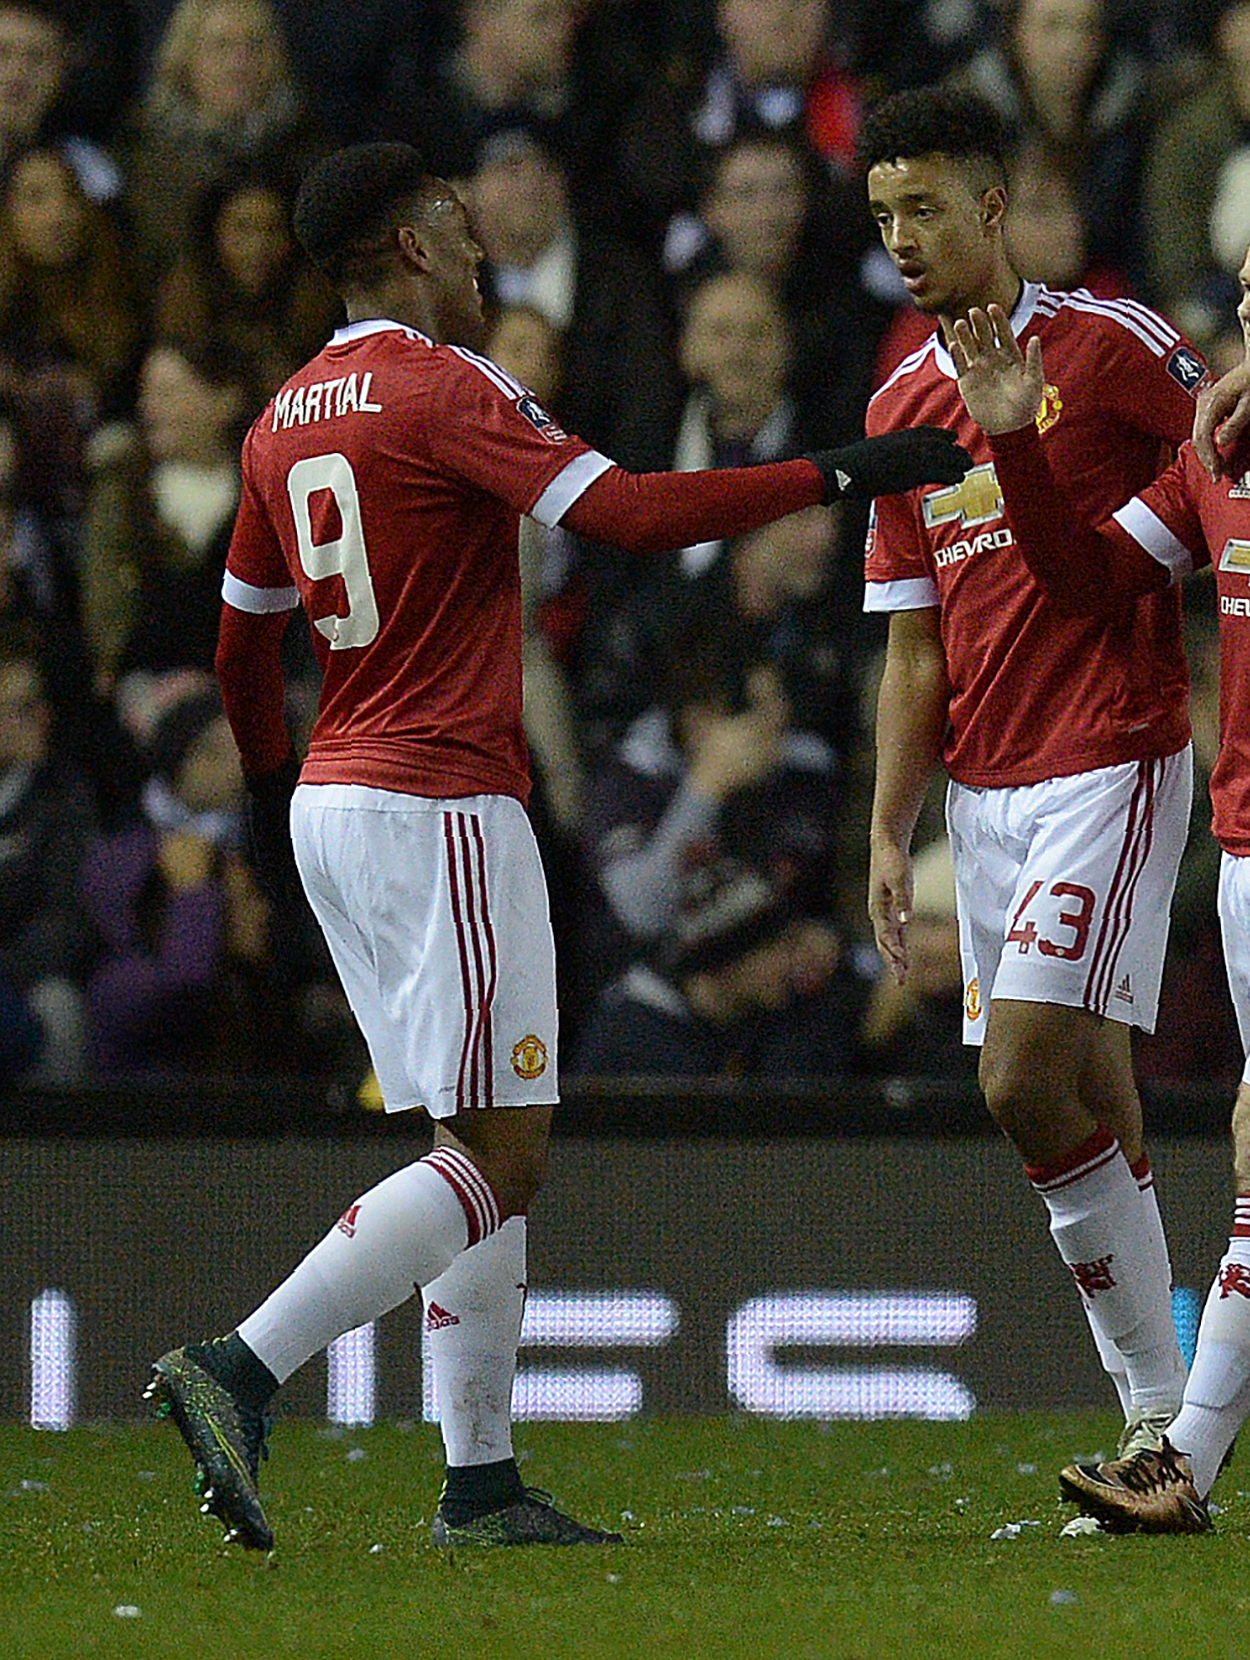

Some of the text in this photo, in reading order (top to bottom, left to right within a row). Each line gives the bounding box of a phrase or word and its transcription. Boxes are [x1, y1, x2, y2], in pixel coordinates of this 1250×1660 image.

[271, 372, 382, 432] MARTIAL
[287, 452, 380, 650] 9
[933, 528, 1017, 568] CHEVRO
[1007, 880, 1097, 962] 43
